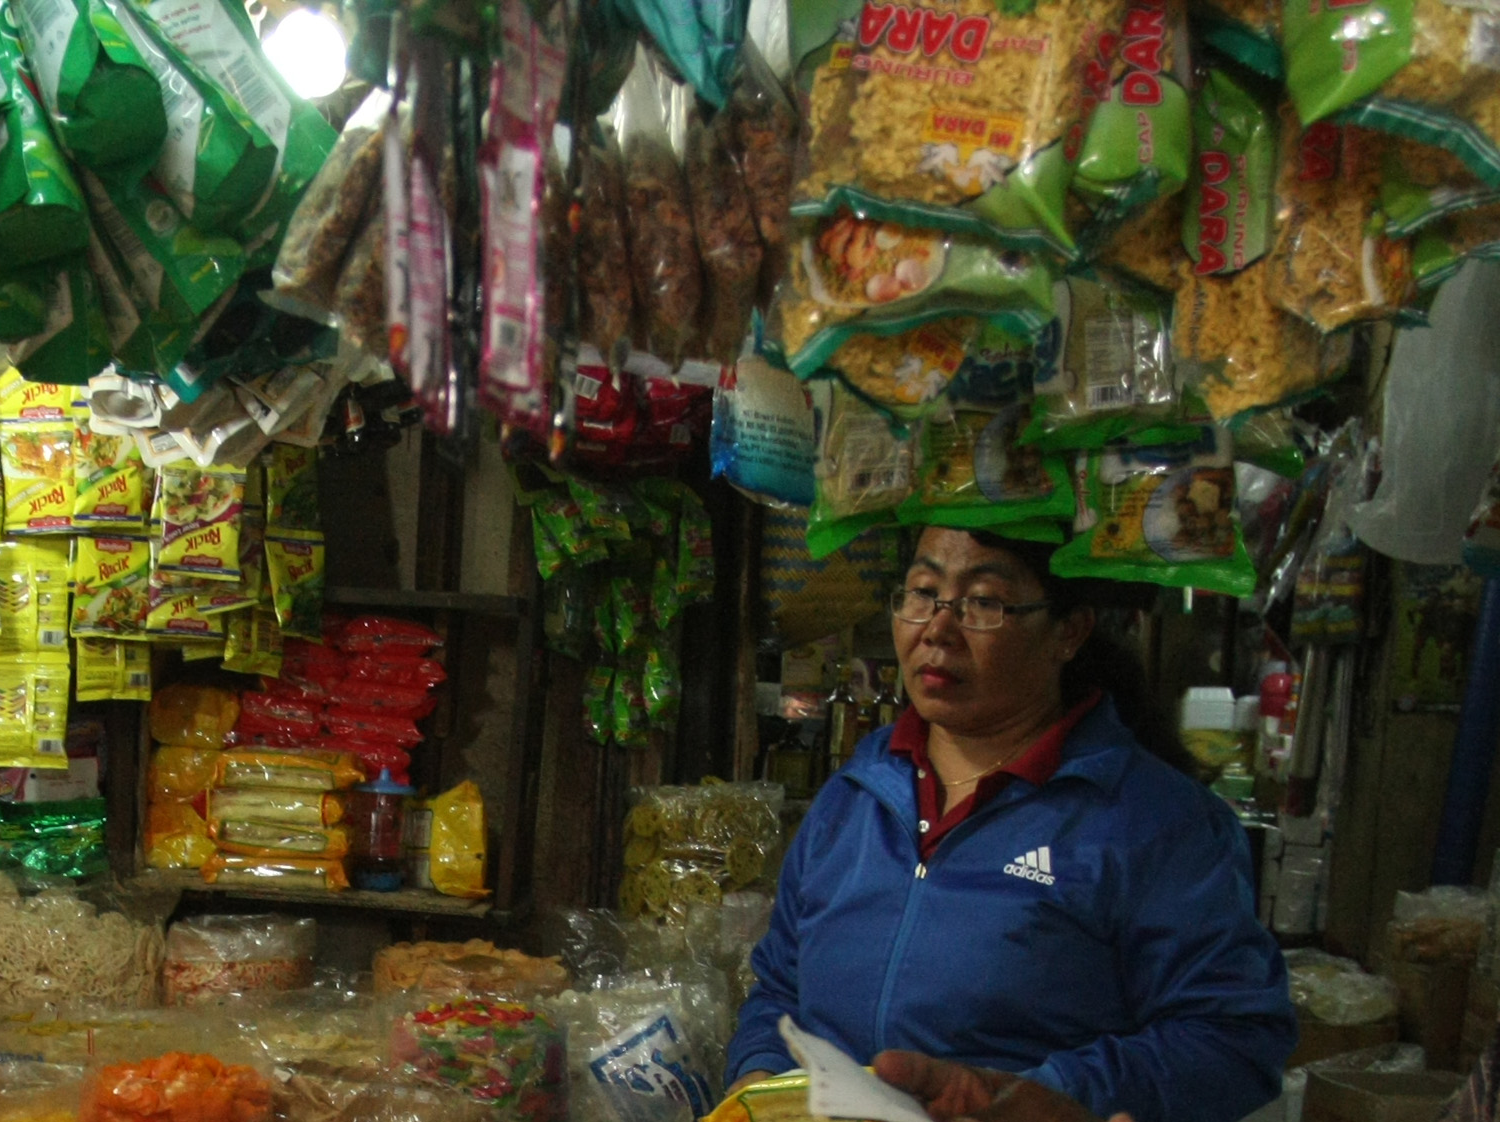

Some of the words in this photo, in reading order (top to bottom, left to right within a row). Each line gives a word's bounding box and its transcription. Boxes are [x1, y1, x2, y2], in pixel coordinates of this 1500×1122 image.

[858, 0, 991, 63] DARA
[1121, 0, 1165, 106] DAR
[1195, 150, 1232, 276] DARA
[1003, 862, 1057, 887] adidas
